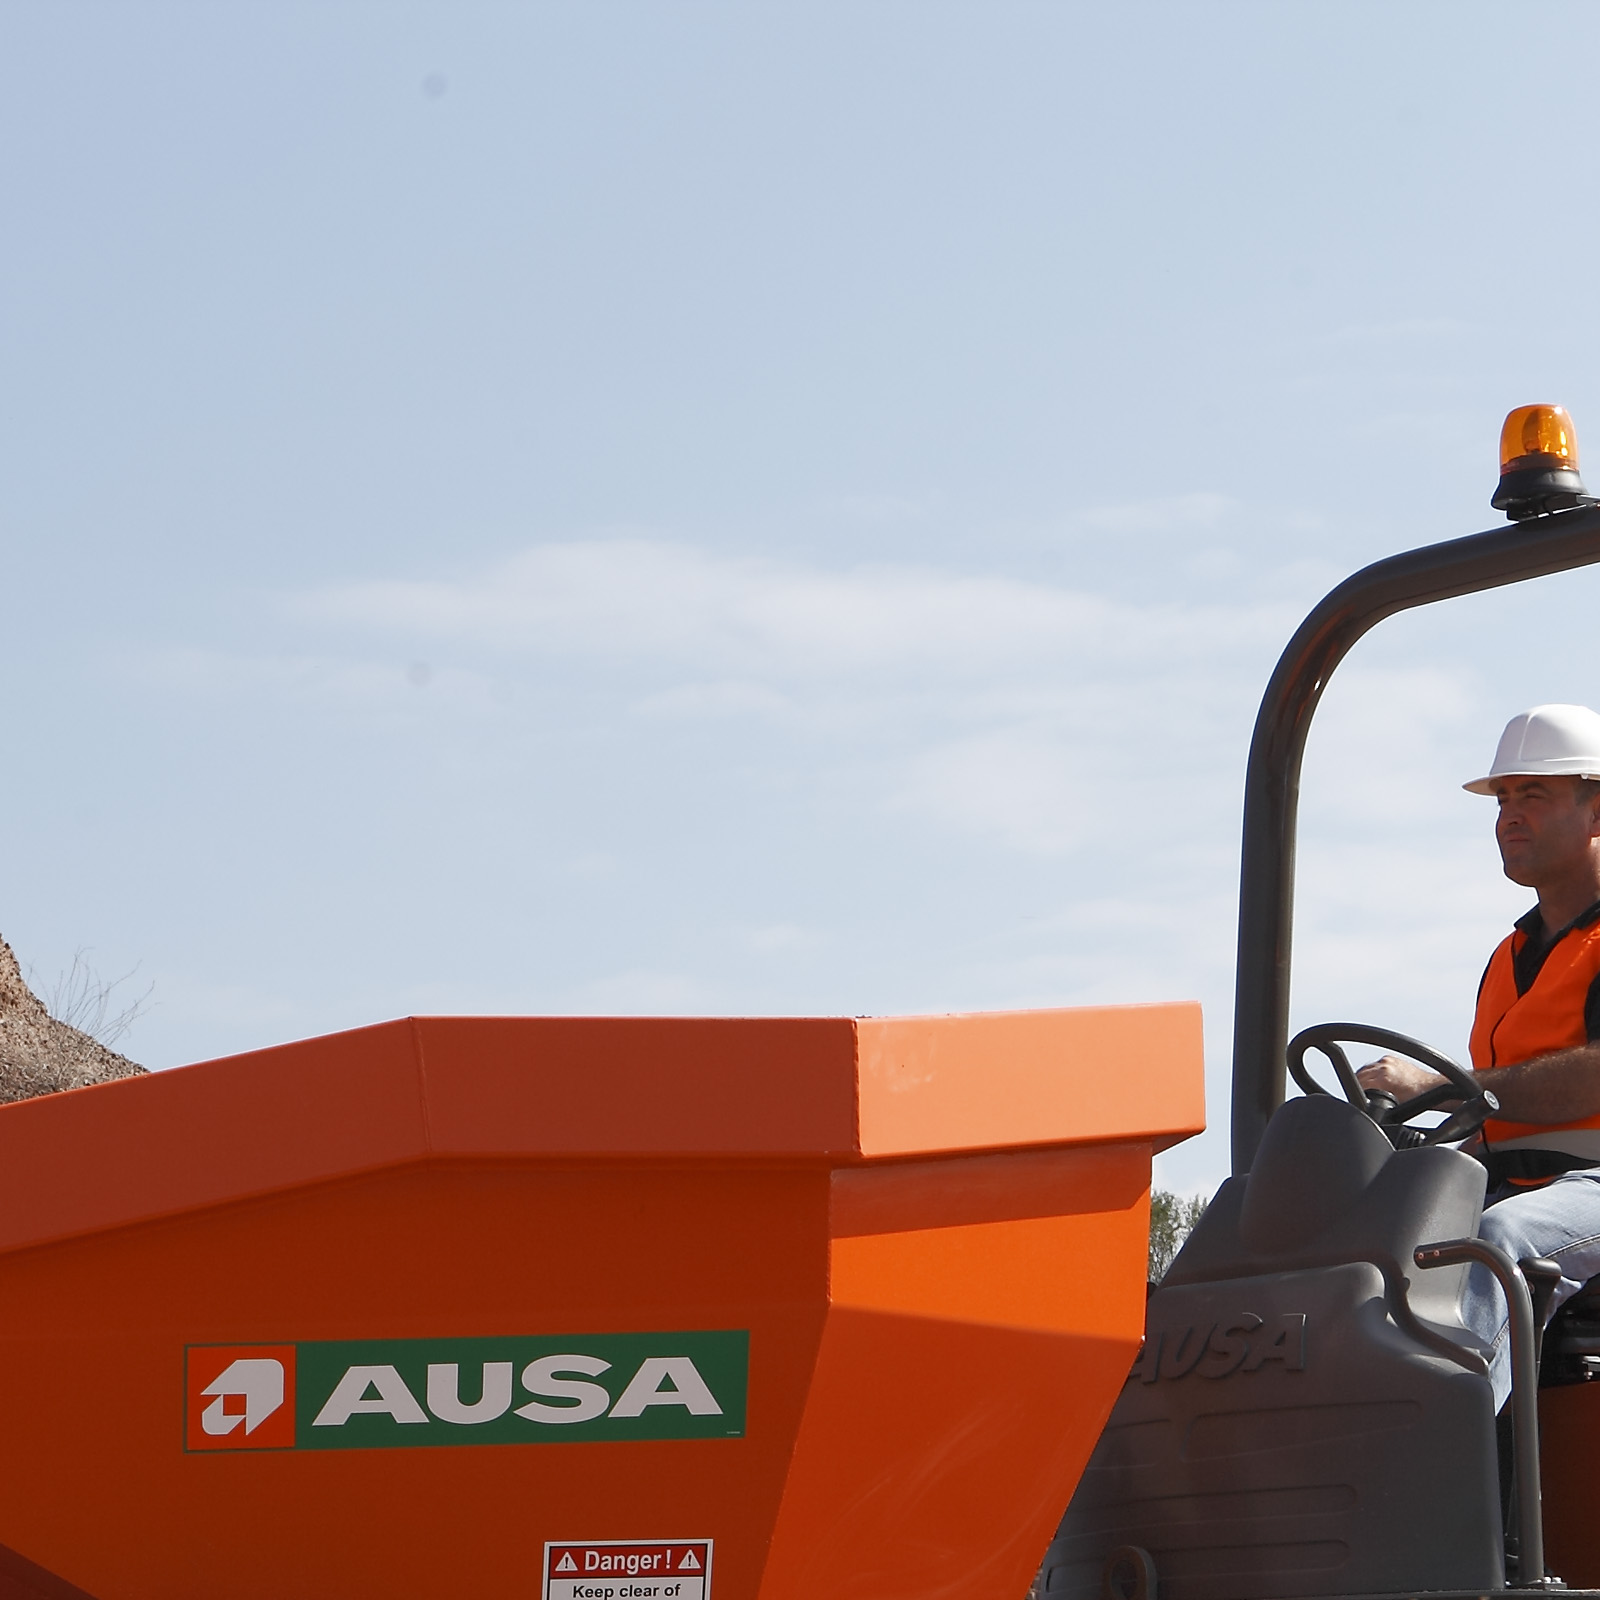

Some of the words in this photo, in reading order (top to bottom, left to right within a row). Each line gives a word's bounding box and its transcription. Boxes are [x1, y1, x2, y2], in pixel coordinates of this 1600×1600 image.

[1128, 1312, 1308, 1384] AUSA
[312, 1354, 723, 1426] AUSA
[572, 1585, 614, 1600] Keep
[619, 1584, 660, 1598] clear
[664, 1583, 681, 1597] of
